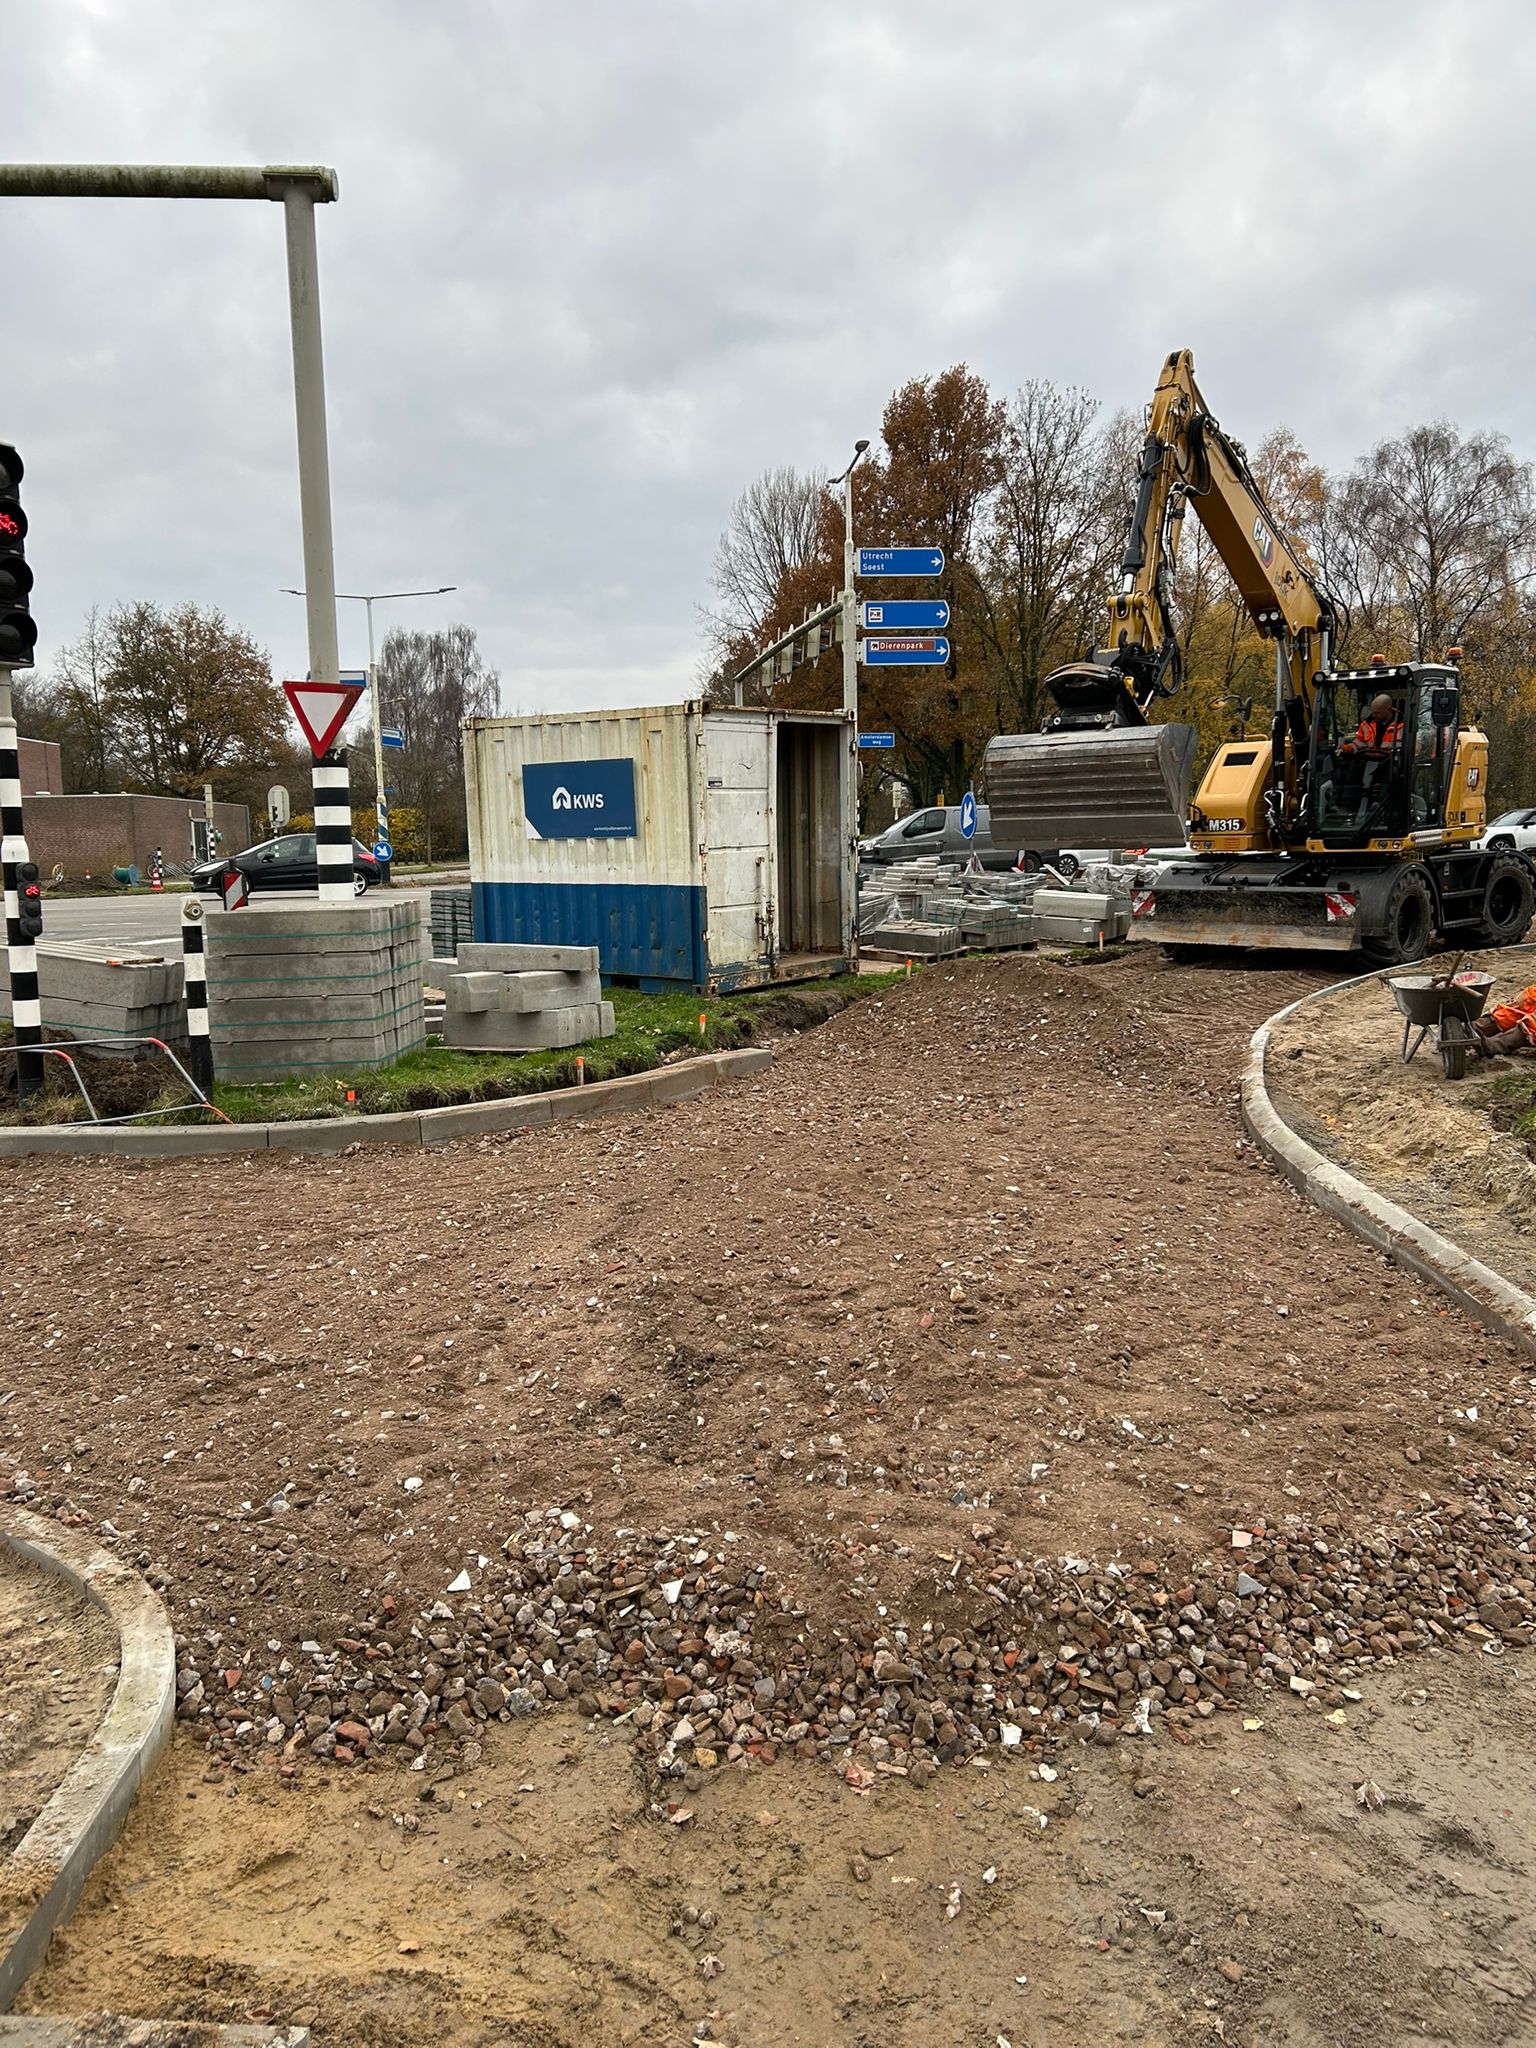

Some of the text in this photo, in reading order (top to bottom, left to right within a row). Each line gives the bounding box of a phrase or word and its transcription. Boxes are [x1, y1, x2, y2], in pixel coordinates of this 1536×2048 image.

[1253, 516, 1272, 557] CAT
[862, 552, 893, 560] Utrecht
[862, 563, 885, 571] Soest
[880, 642, 924, 650] Dierenpark
[1467, 768, 1479, 787] CAT
[573, 793, 605, 809] KWS
[1208, 819, 1240, 832] M315
